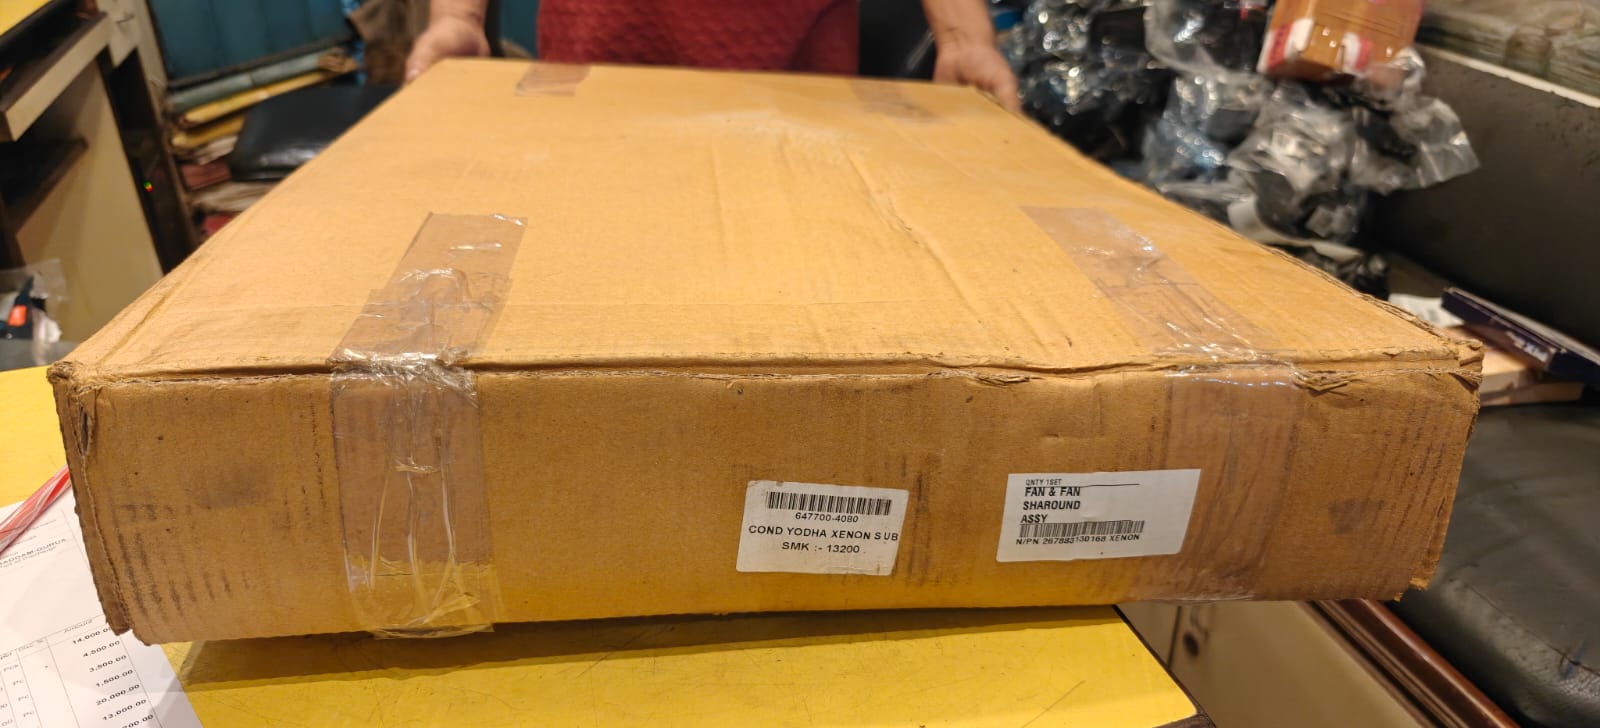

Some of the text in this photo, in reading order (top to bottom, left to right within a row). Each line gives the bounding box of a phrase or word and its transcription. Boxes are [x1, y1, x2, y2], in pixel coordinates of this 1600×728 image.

[1025, 486, 1080, 497] FAN & FAN
[1022, 500, 1081, 511] SHAROUND
[795, 511, 859, 523] 647700-4080
[1020, 513, 1048, 523] ASSY
[748, 524, 784, 535] COND
[787, 527, 827, 538] YODHA
[831, 530, 871, 540] XENON
[1109, 534, 1140, 542] XENON
[781, 541, 809, 551] SMK
[827, 544, 860, 554] 13200
